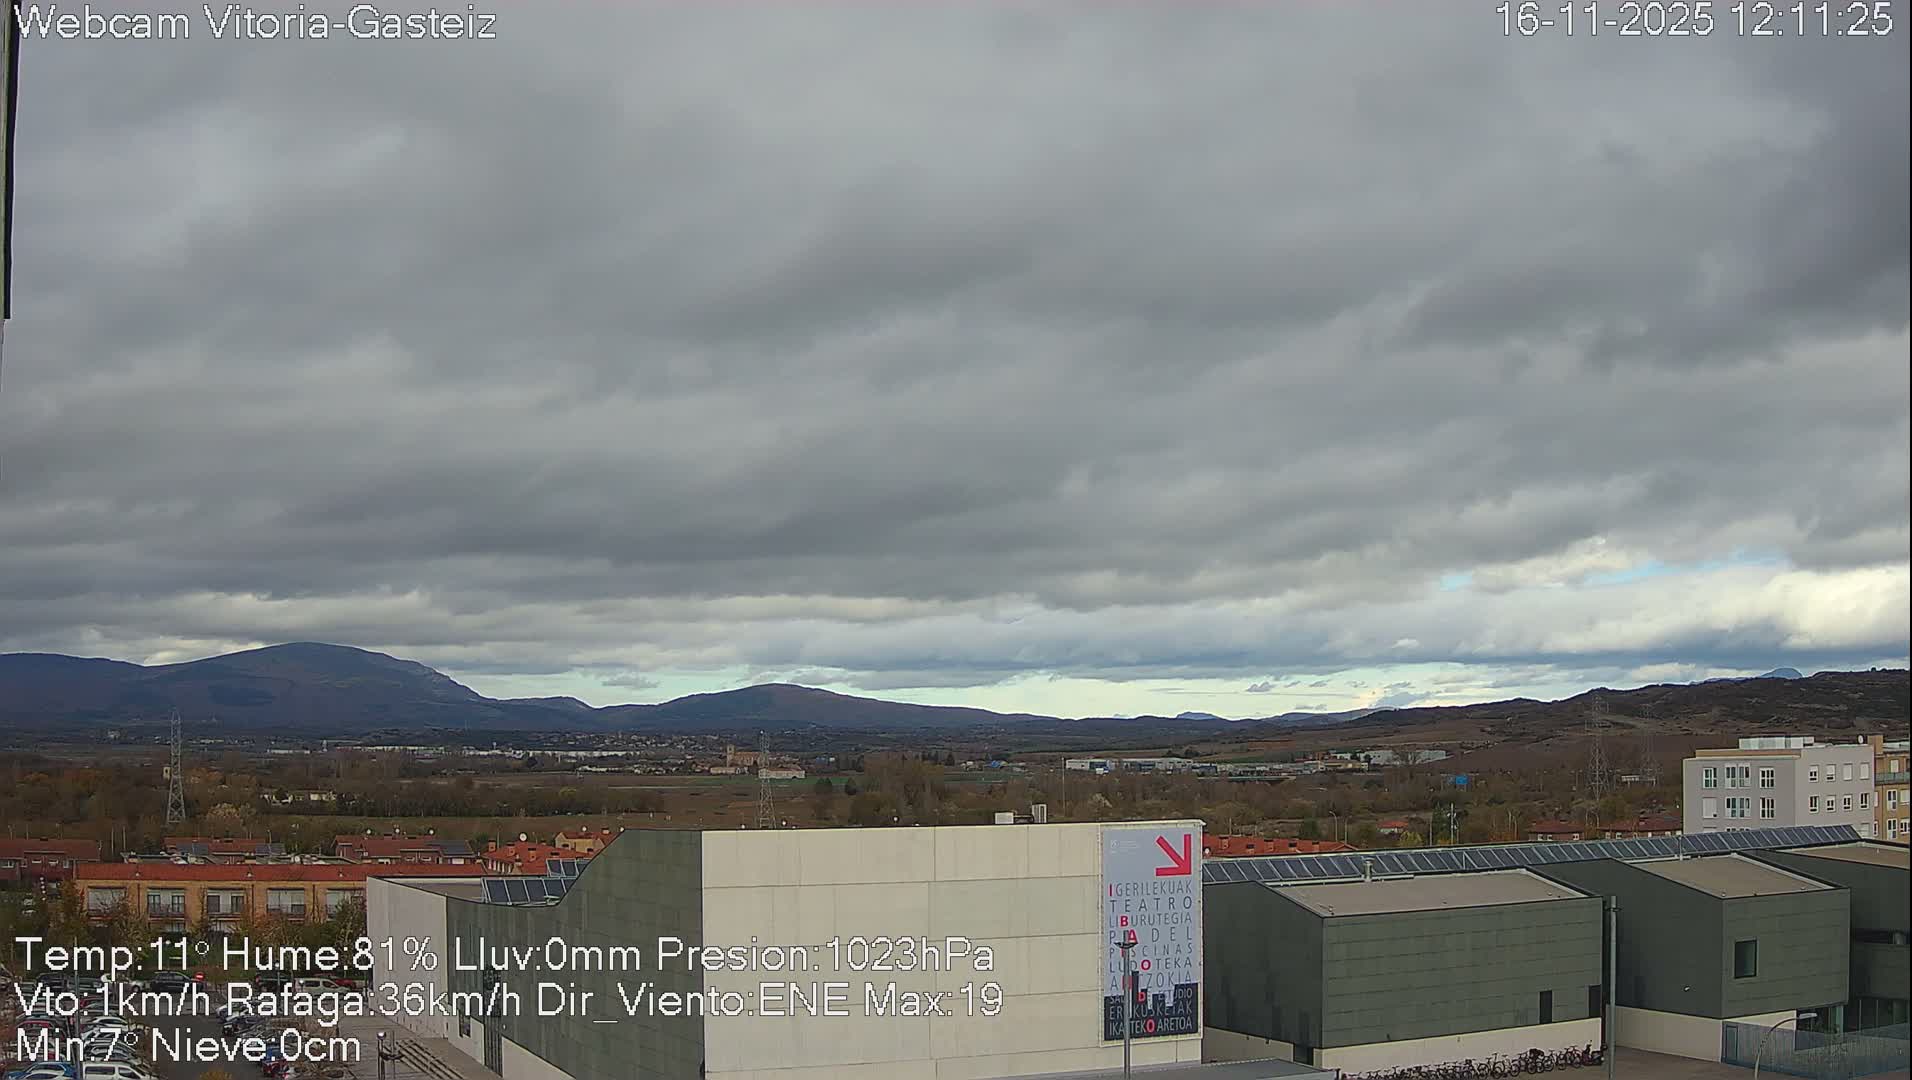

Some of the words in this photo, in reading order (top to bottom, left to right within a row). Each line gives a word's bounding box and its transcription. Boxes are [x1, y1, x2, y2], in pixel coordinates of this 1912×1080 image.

[1109, 880, 1192, 897] IGERILEKUAK
[1109, 896, 1193, 913] TEATRO
[1109, 912, 1192, 928] LIBURUTEGIA
[1109, 956, 1192, 973] LUDOTEKA
[1110, 970, 1192, 991] AZOKIA
[1109, 999, 1193, 1020] ERKUSKETAK
[1109, 1017, 1155, 1036] IKATEKO
[1156, 1015, 1193, 1032] ARETOA
